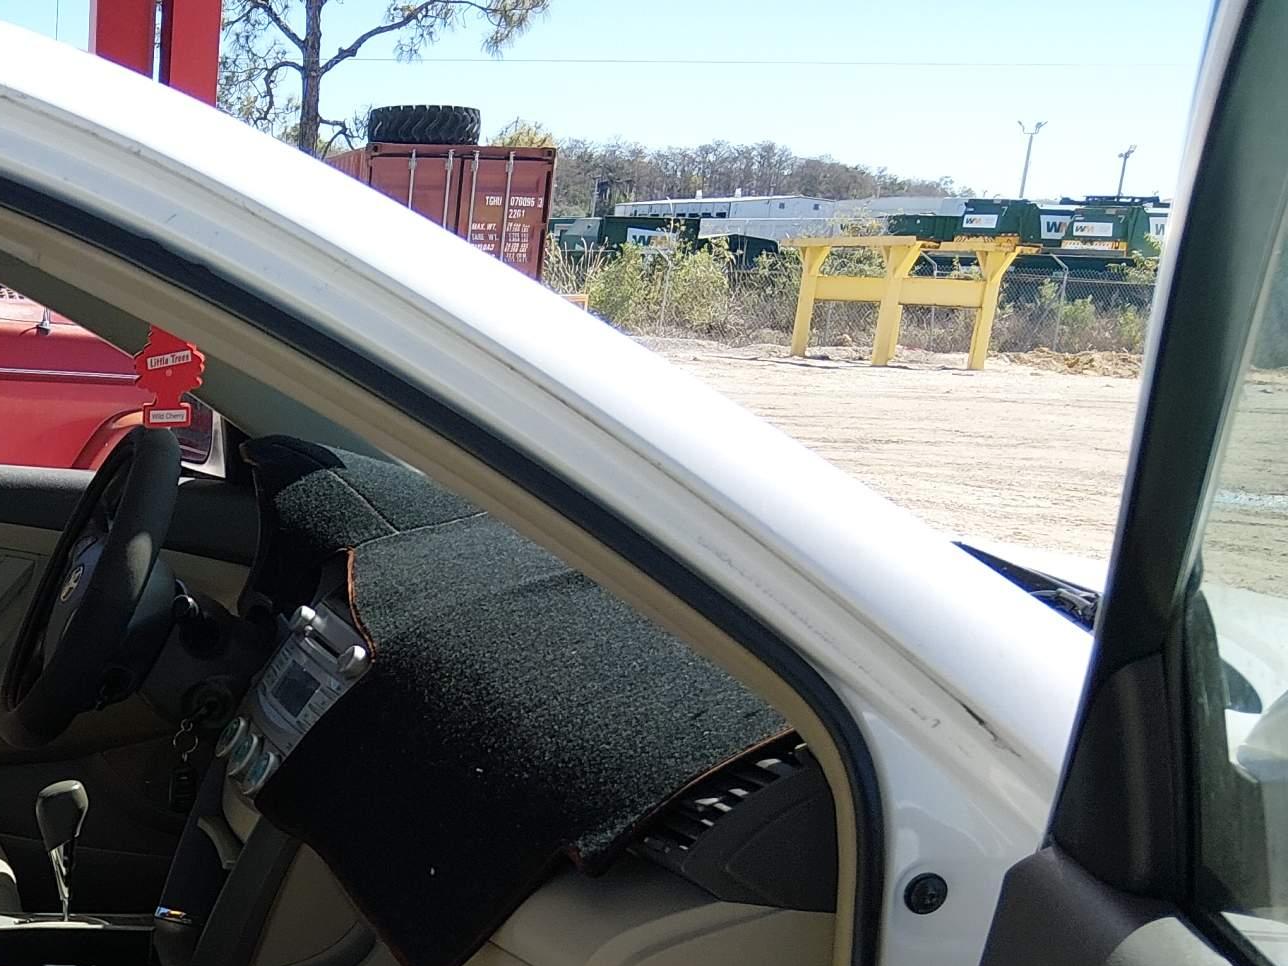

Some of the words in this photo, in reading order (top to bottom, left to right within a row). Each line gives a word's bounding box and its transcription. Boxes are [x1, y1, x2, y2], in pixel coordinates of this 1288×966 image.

[485, 195, 502, 206] TGHU
[510, 196, 535, 207] 070095
[1001, 206, 1008, 216] 7
[1118, 215, 1125, 223] 7
[150, 356, 168, 368] Little
[171, 353, 189, 364] Trees
[166, 412, 185, 421] Cherry
